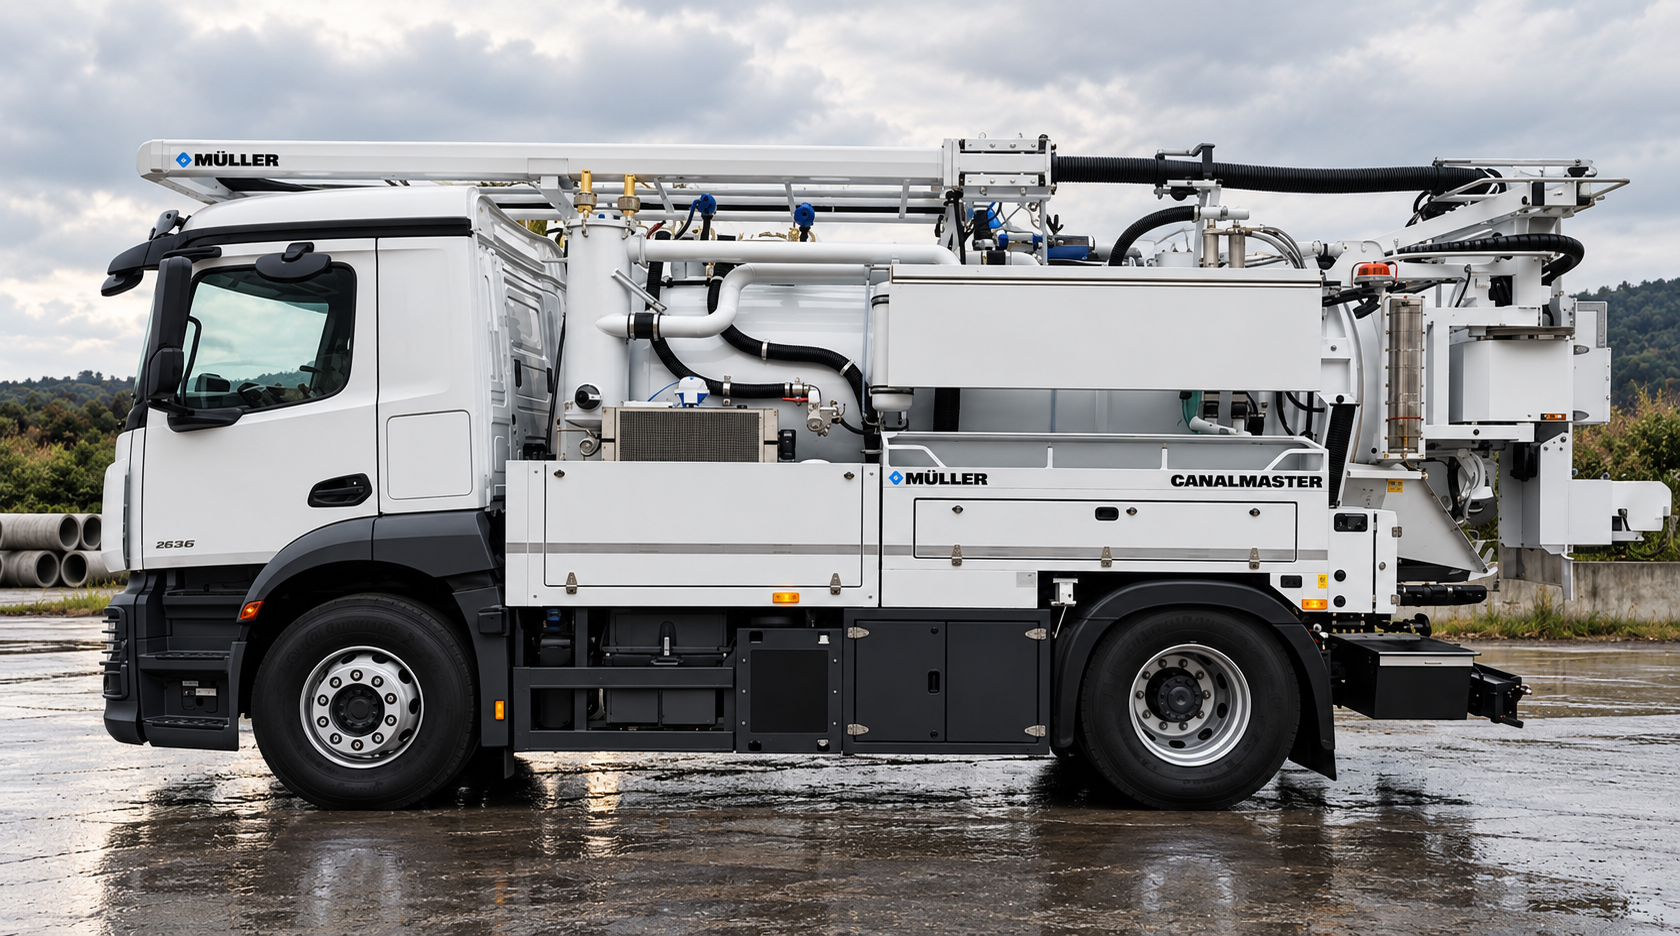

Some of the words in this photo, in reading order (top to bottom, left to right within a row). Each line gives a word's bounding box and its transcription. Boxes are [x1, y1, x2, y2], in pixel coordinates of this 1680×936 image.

[194, 150, 279, 167] MÜLLER
[905, 469, 988, 486] MÜLLER
[1170, 473, 1323, 489] CANALMASTER
[155, 539, 196, 550] 2636
